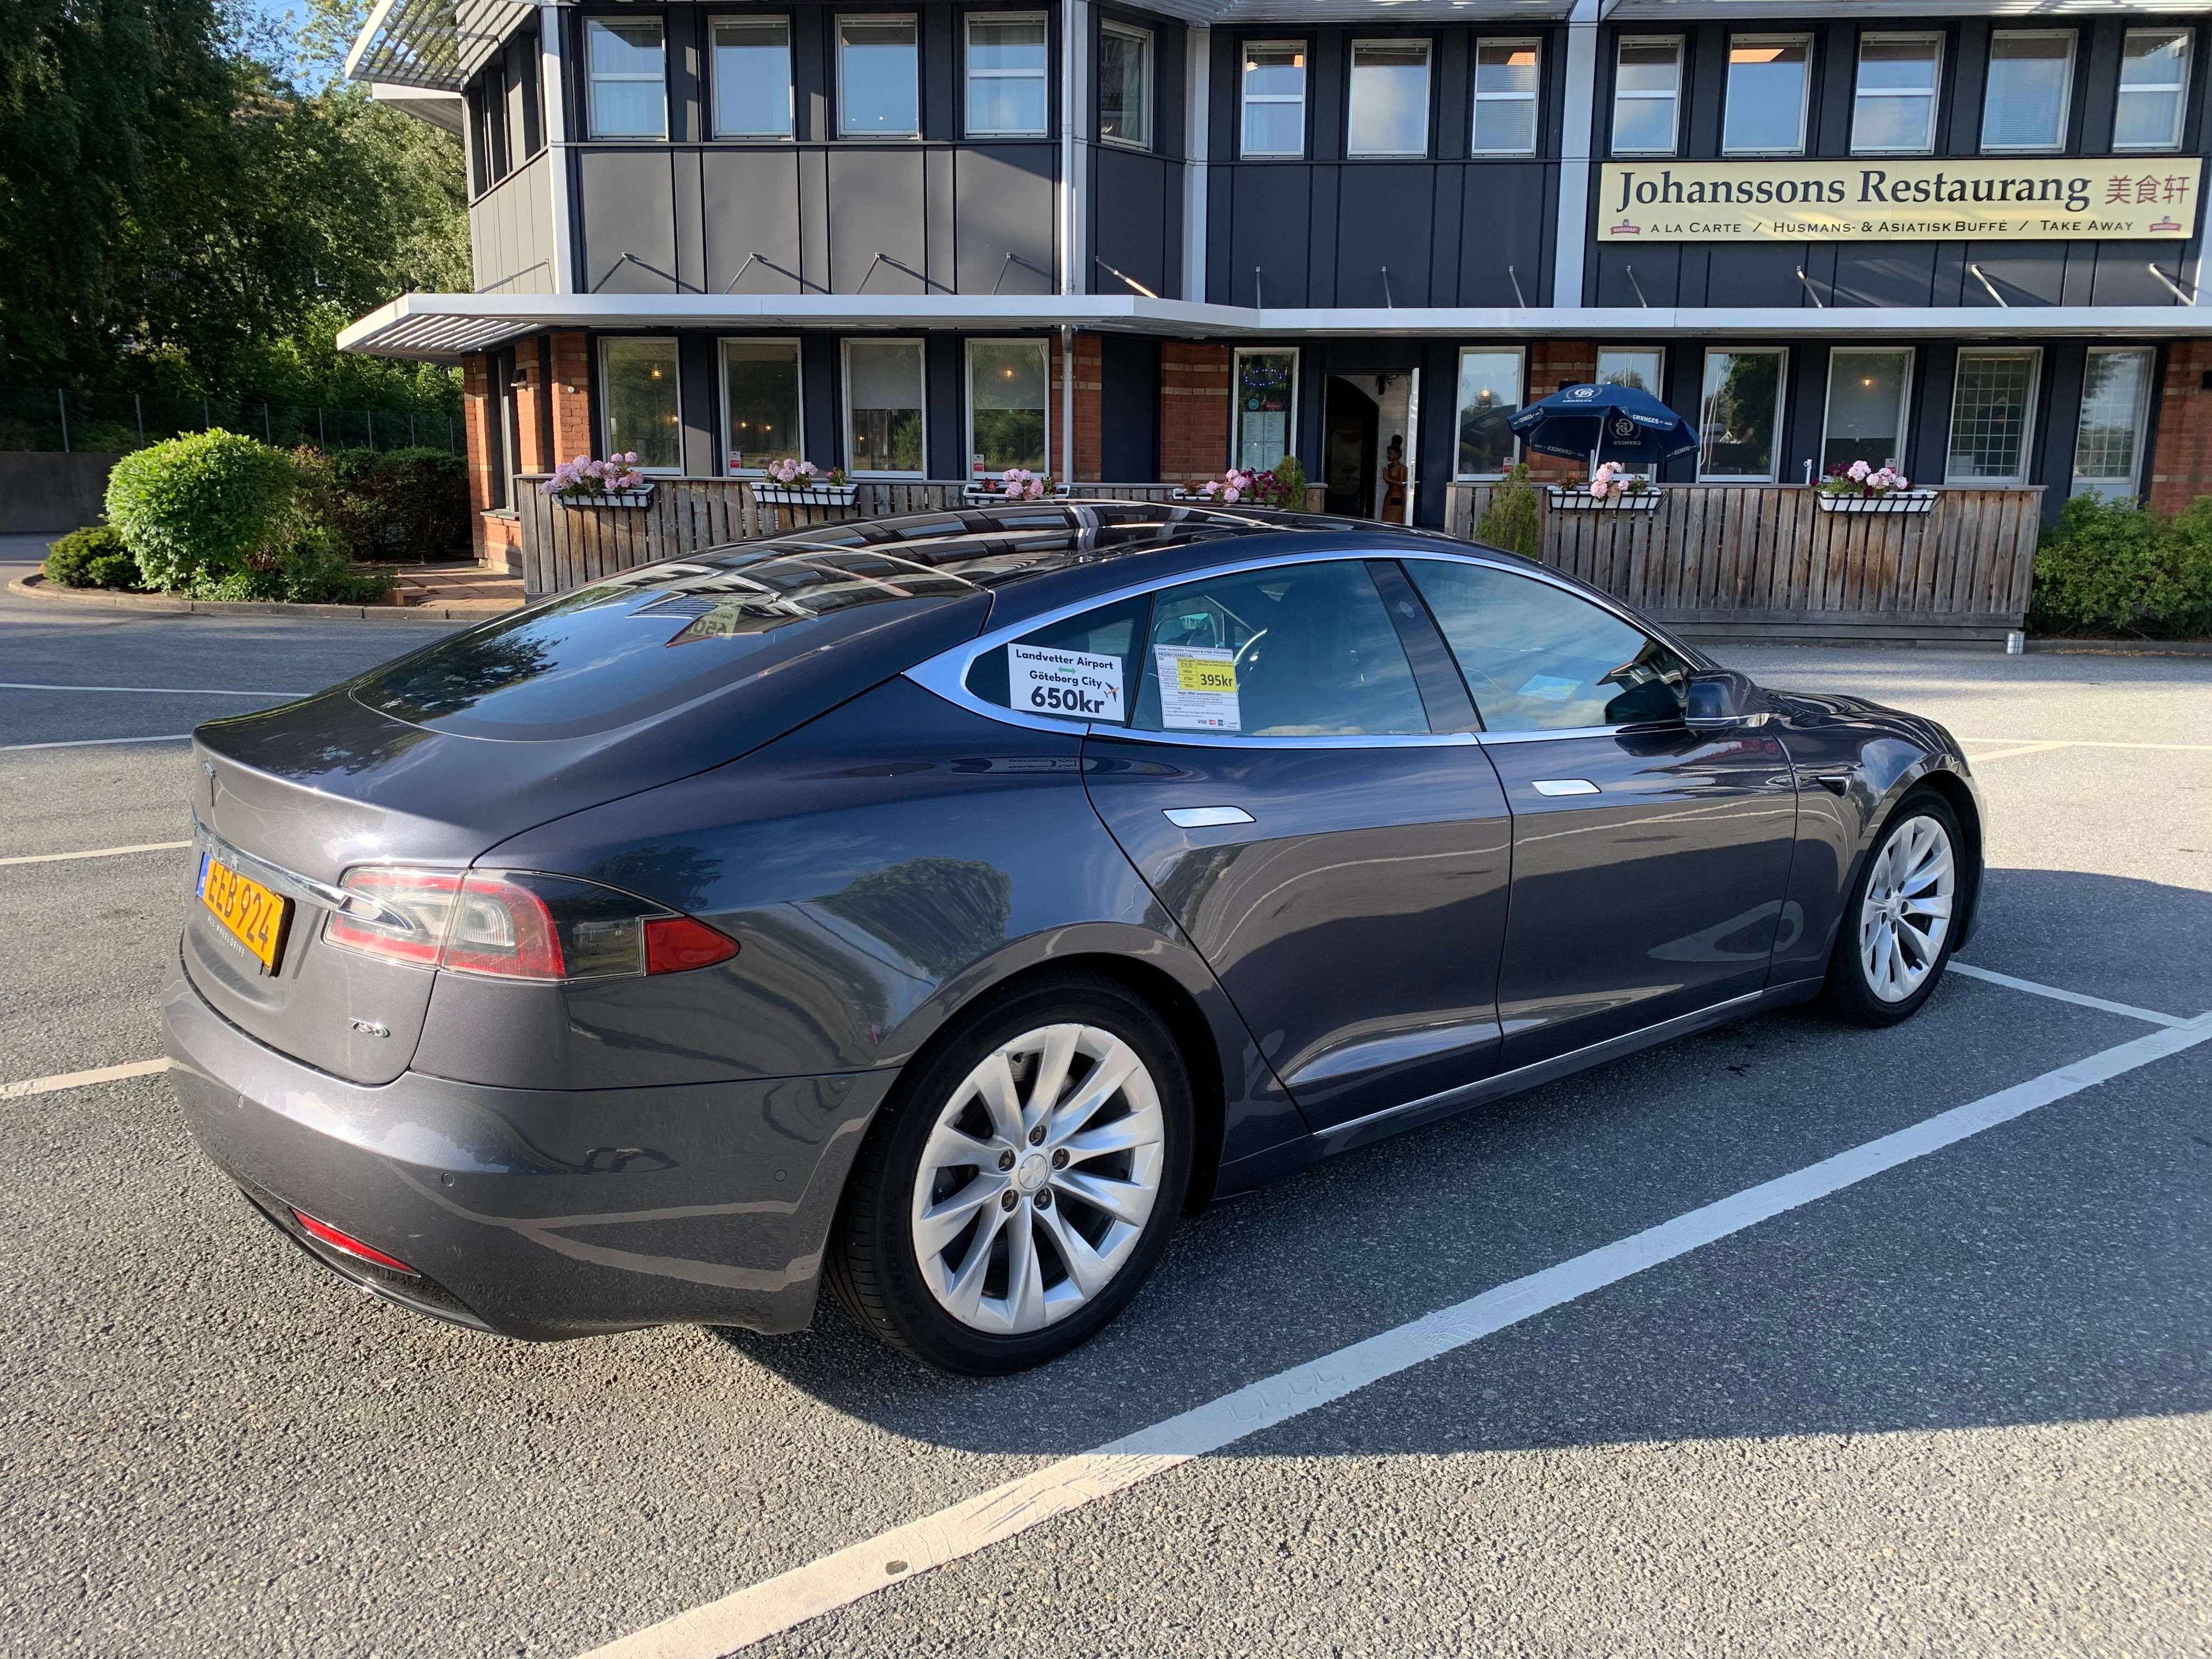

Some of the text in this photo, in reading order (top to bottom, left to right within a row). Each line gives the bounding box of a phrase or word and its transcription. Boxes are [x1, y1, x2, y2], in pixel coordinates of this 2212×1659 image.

[1616, 171, 2092, 213] Johanssons Restaurang
[2105, 174, 2191, 205] 美食轩
[1753, 222, 1762, 233] /
[1774, 222, 1856, 233] HUSMANS-
[1861, 222, 1872, 232] &
[2018, 220, 2029, 230] /
[2040, 220, 2081, 230] TAKE
[2087, 220, 2134, 230] AWAY
[1016, 649, 1114, 669] Landvetter Airport
[1030, 670, 1102, 689] Göteborg City
[1200, 674, 1233, 687] 395kr
[1031, 686, 1105, 713] 650kr
[208, 861, 274, 952] EEB 924
[230, 938, 245, 957] DRIVE
